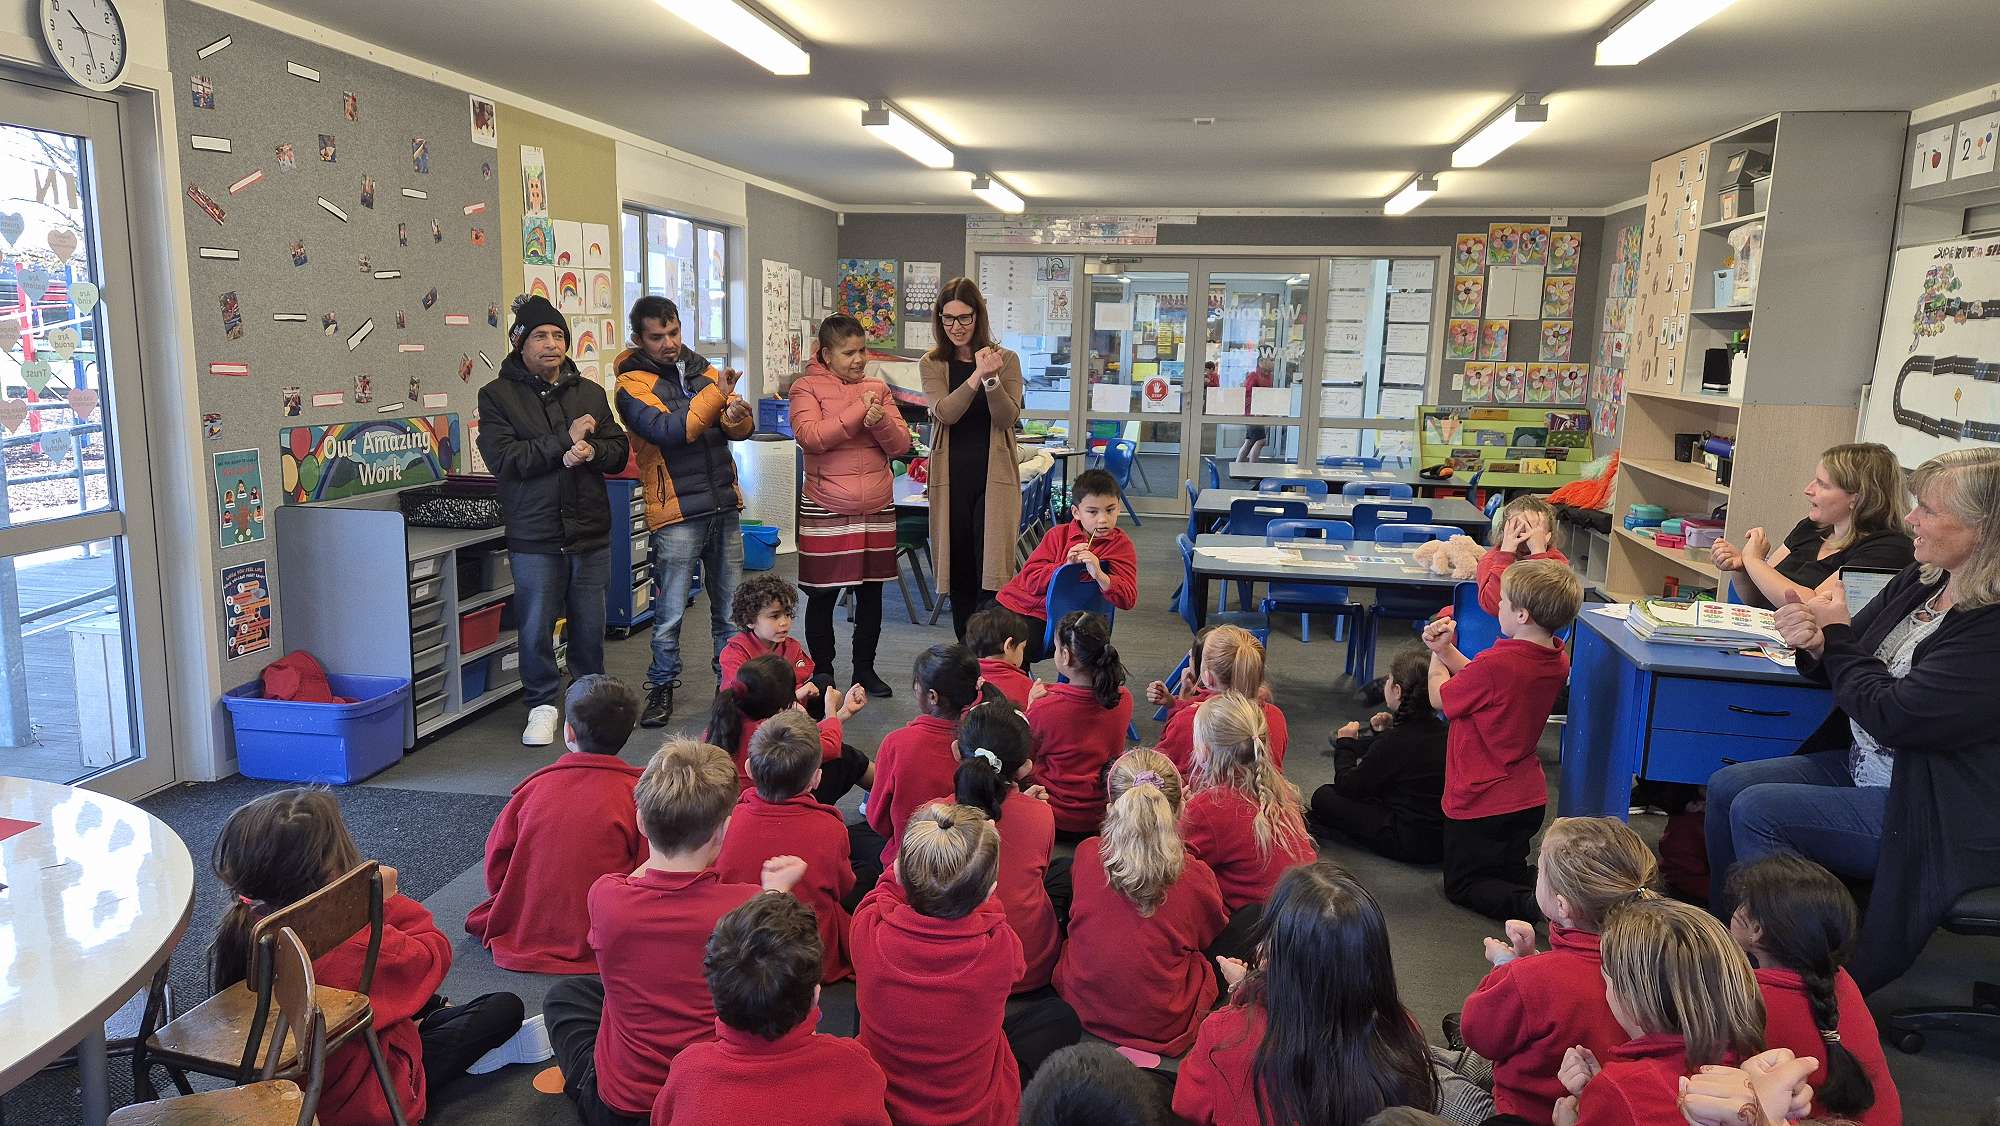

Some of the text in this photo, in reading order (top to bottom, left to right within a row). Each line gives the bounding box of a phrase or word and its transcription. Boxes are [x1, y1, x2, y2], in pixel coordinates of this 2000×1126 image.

[104, 12, 110, 24] 2
[112, 34, 116, 45] 3
[70, 56, 75, 67] 7
[1961, 138, 1971, 161] 2
[1922, 151, 1926, 173] 1
[1655, 173, 1661, 197] 1
[1660, 192, 1668, 216] 2
[1649, 214, 1656, 238] 3
[1655, 234, 1662, 258] 4
[1645, 252, 1651, 275] 5
[1652, 271, 1659, 295] 6
[1641, 293, 1647, 315] 7
[1648, 314, 1654, 338] 8
[323, 426, 431, 459] Our Amazing
[358, 457, 402, 486] Work
